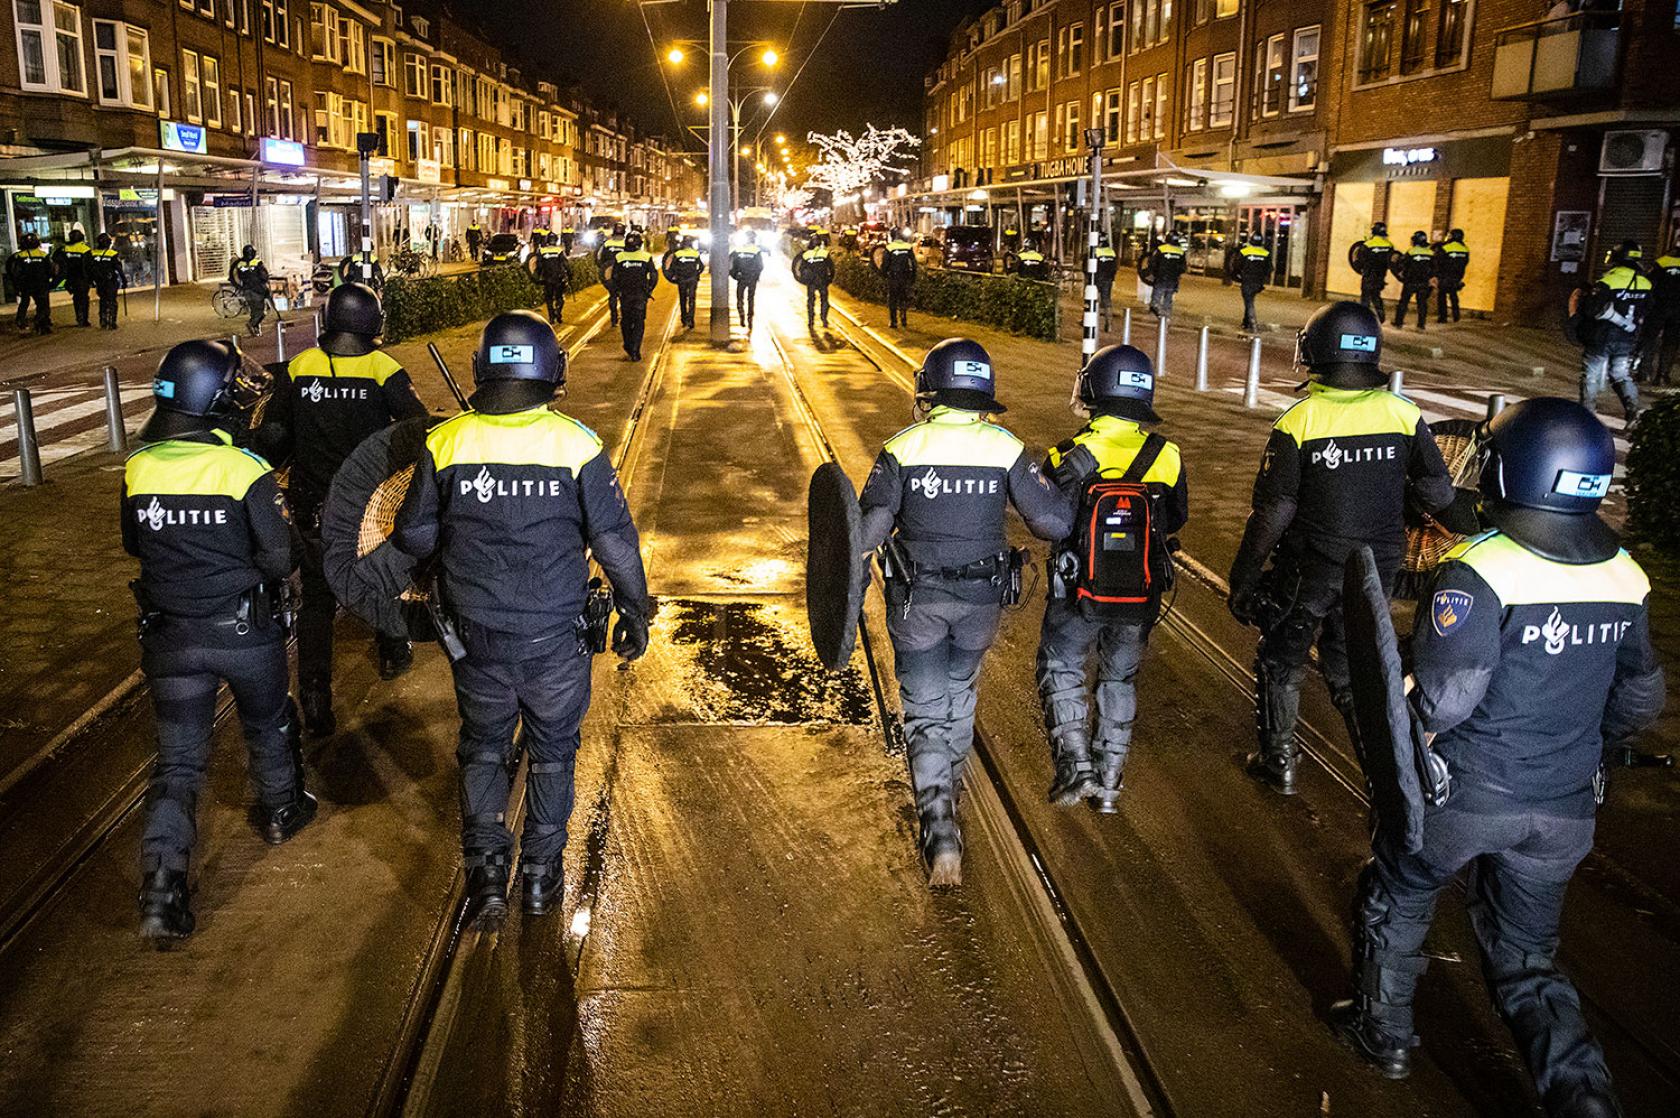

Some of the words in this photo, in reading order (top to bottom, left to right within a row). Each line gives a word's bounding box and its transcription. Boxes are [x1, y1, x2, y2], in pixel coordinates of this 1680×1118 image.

[1065, 156, 1089, 176] HOME
[301, 377, 368, 403] POLITIE
[1312, 439, 1396, 469] POLITIE
[460, 465, 560, 503] POLITIE
[911, 466, 999, 499] POLITIE
[137, 496, 227, 531] POLITIE
[1436, 592, 1469, 607] POLITIE
